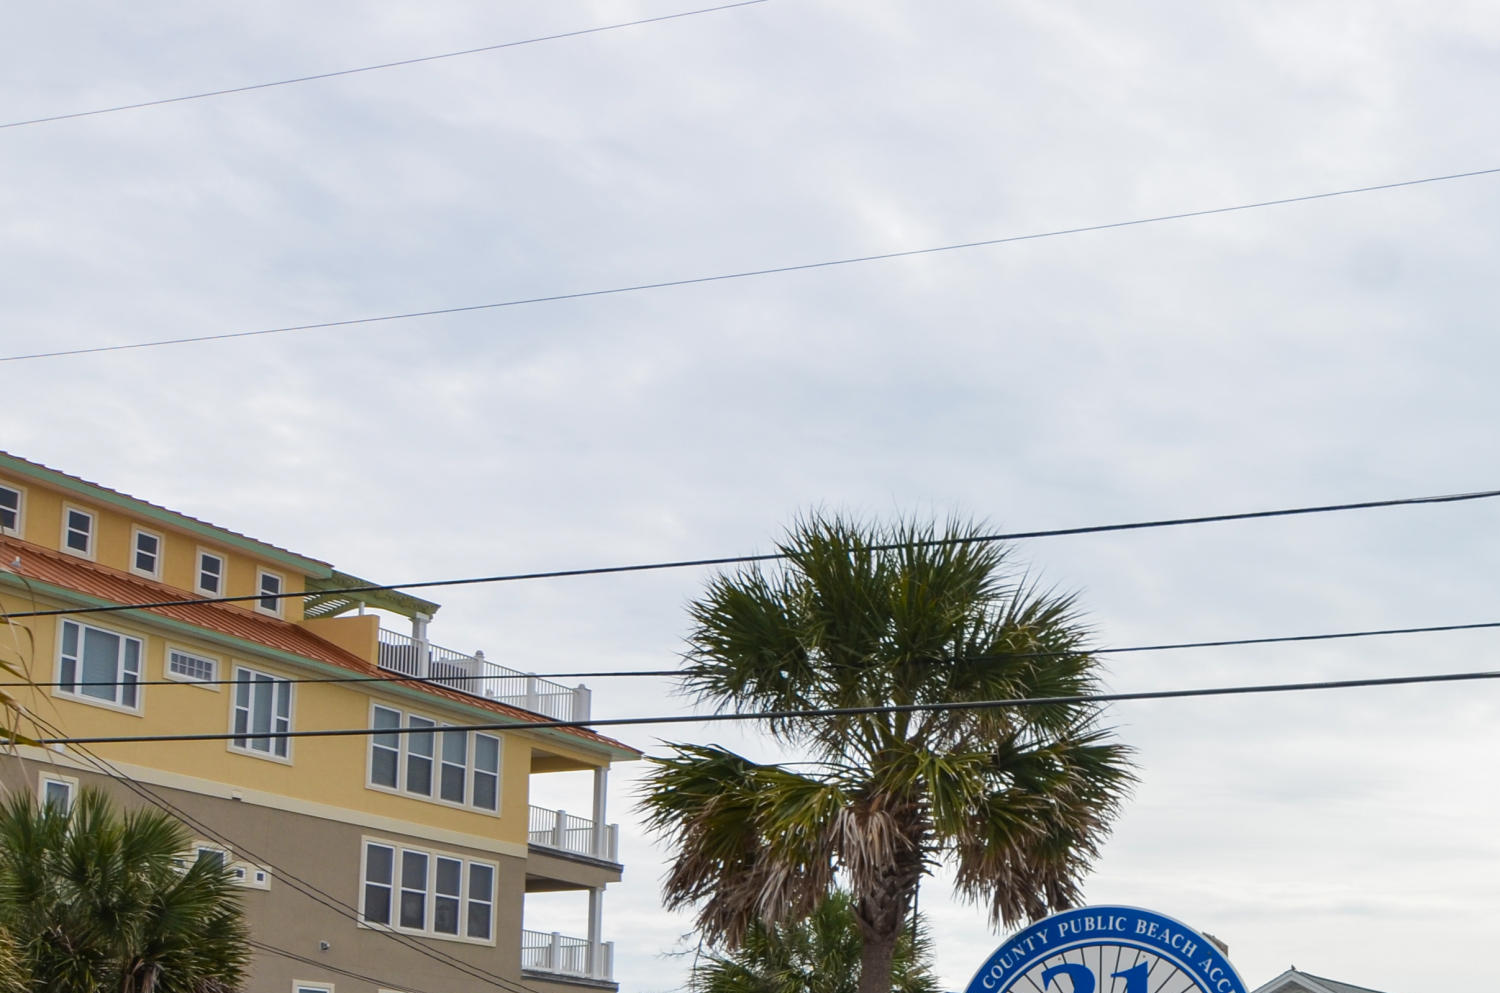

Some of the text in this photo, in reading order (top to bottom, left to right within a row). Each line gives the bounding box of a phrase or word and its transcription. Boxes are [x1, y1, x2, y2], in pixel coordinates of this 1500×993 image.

[982, 928, 1050, 990] COUNTY
[1057, 915, 1128, 938] PUBLIC
[1135, 918, 1198, 957] BEACH
